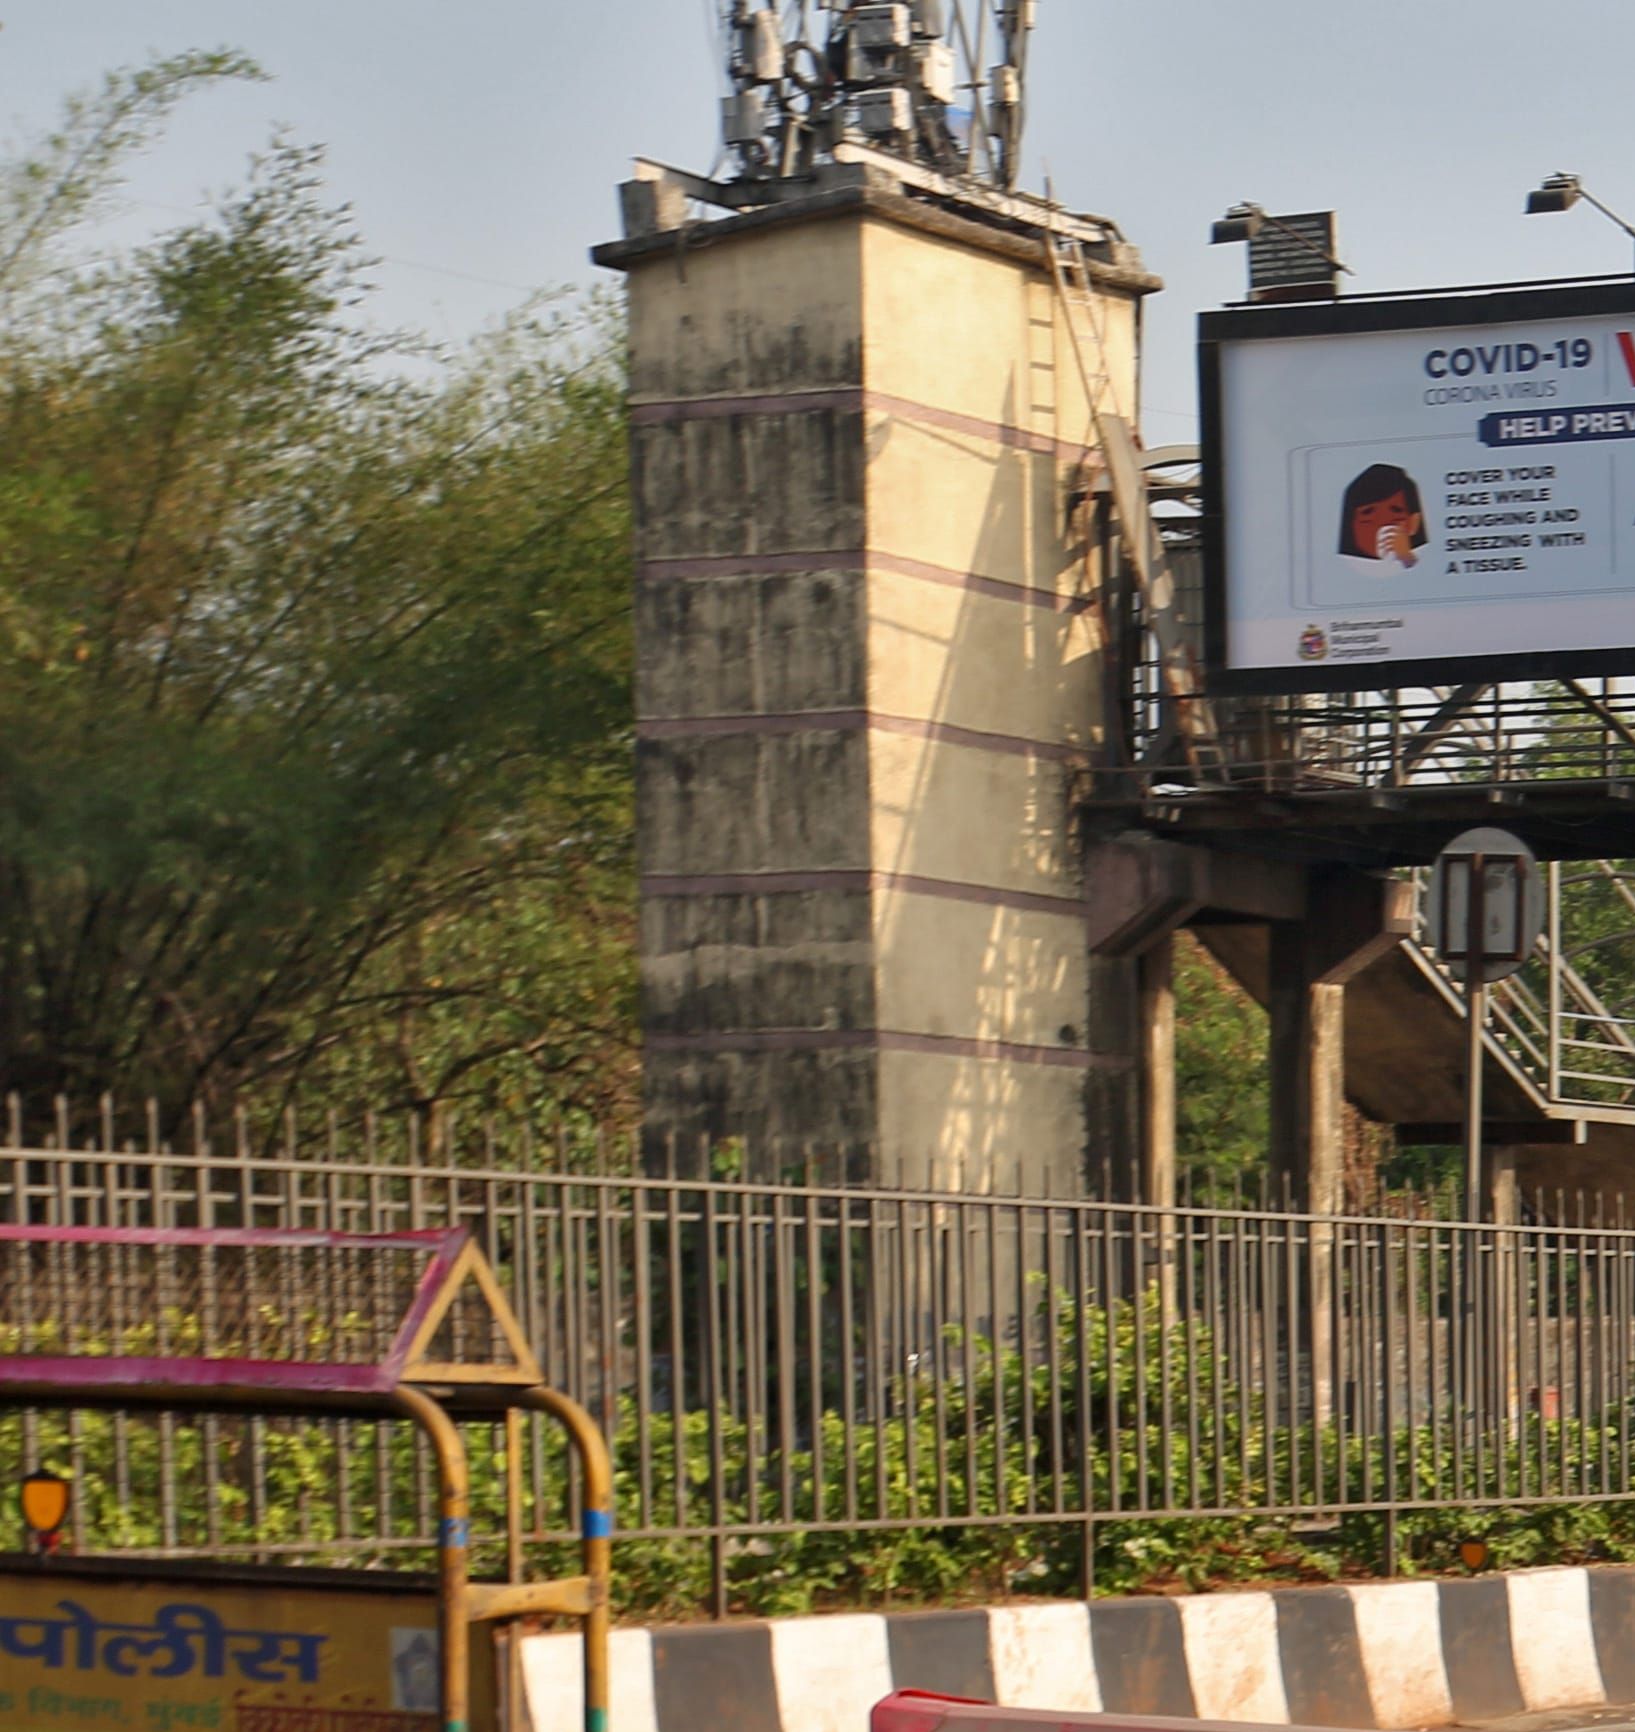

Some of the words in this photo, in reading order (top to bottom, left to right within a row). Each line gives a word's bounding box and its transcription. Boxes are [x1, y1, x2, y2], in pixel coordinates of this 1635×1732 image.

[1424, 337, 1593, 380] COVID-19
[1423, 383, 1499, 406] CORONA
[1502, 379, 1557, 401] VIRUS
[1499, 414, 1563, 441] HELP
[1446, 469, 1504, 485] COVER
[1507, 465, 1556, 480] YOUR
[1446, 491, 1490, 506] FACE
[1495, 488, 1551, 503] WHILE
[1446, 511, 1536, 529] COUGHING
[1541, 508, 1579, 524] AND
[1446, 534, 1532, 551] SNEEZING
[1538, 532, 1586, 547] WITH
[1446, 561, 1459, 574] A
[1462, 557, 1528, 573] TISSUE.
[0, 1601, 329, 1684] पोलीस
